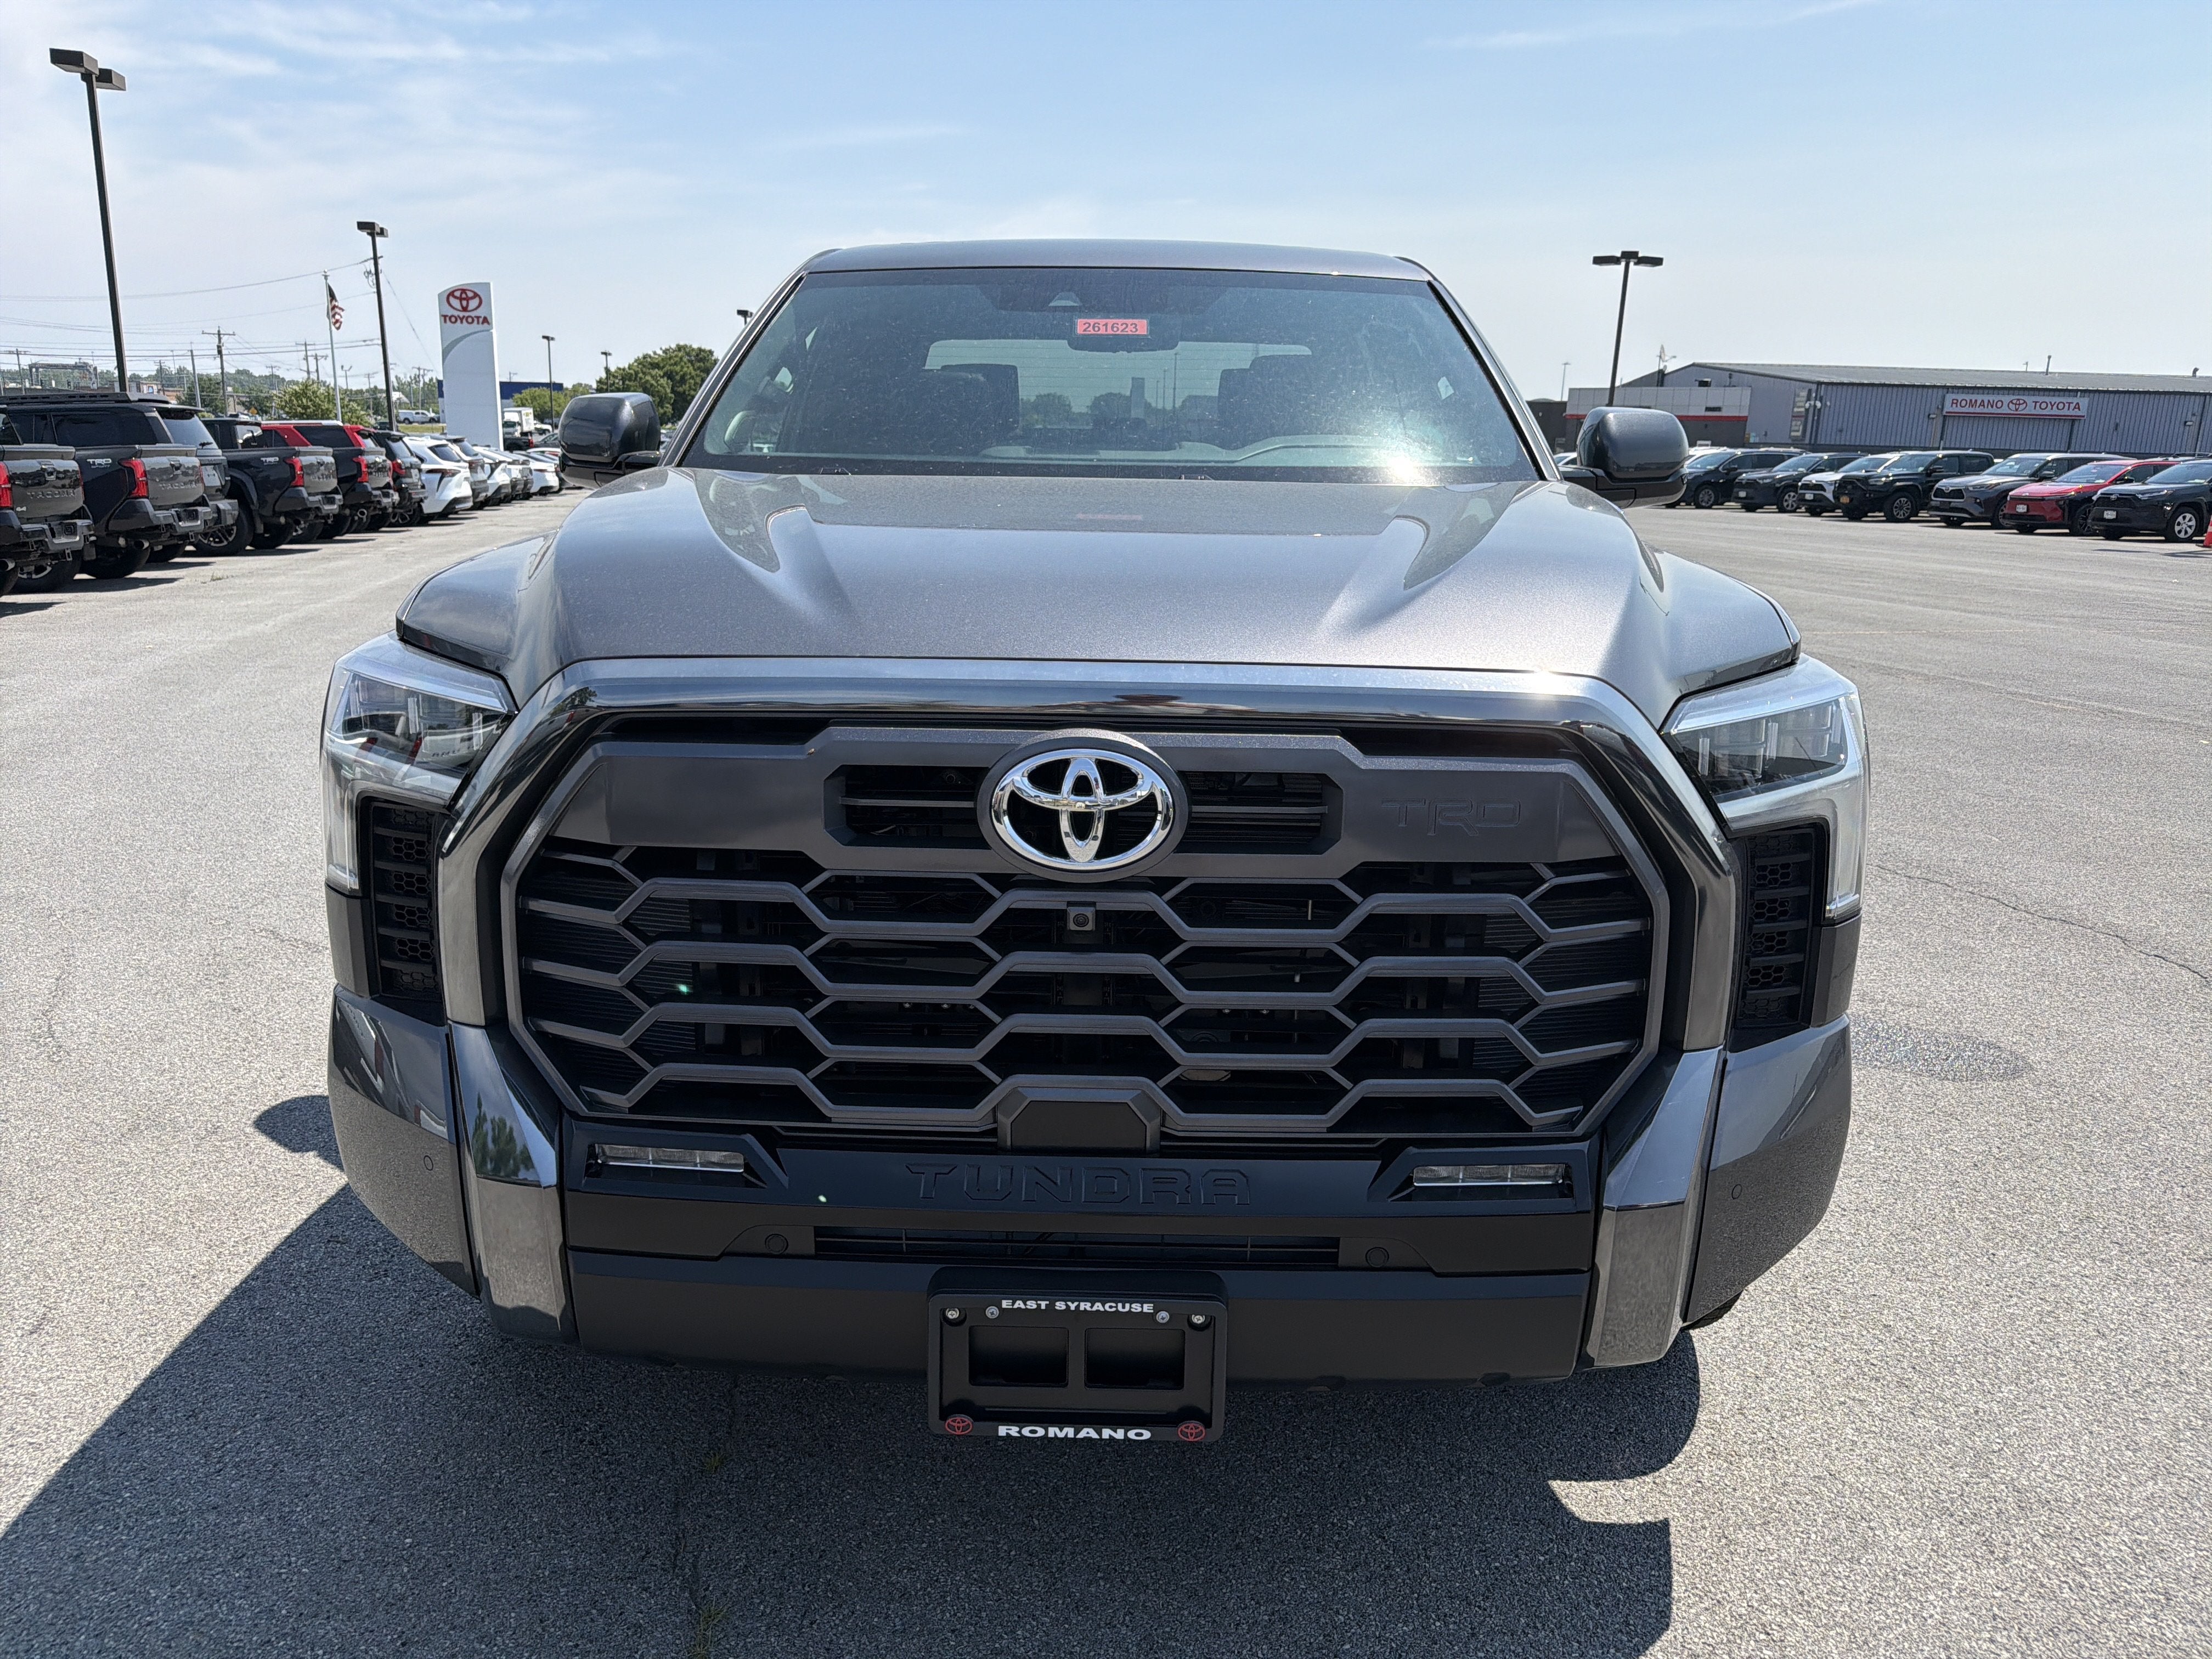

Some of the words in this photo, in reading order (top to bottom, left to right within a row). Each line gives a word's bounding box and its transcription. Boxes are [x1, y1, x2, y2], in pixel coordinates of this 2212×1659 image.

[441, 314, 490, 325] TOYOTA
[1082, 321, 1139, 333] 261623
[1950, 398, 2004, 409] ROMANO
[2032, 400, 2081, 411] TOYOTA
[1381, 798, 1521, 836] TRD
[905, 1163, 1250, 1205] TUNDRA
[1001, 1299, 1049, 1310] EAST
[1054, 1301, 1154, 1313] SYRACUSE
[997, 1425, 1152, 1441] ROMANO
